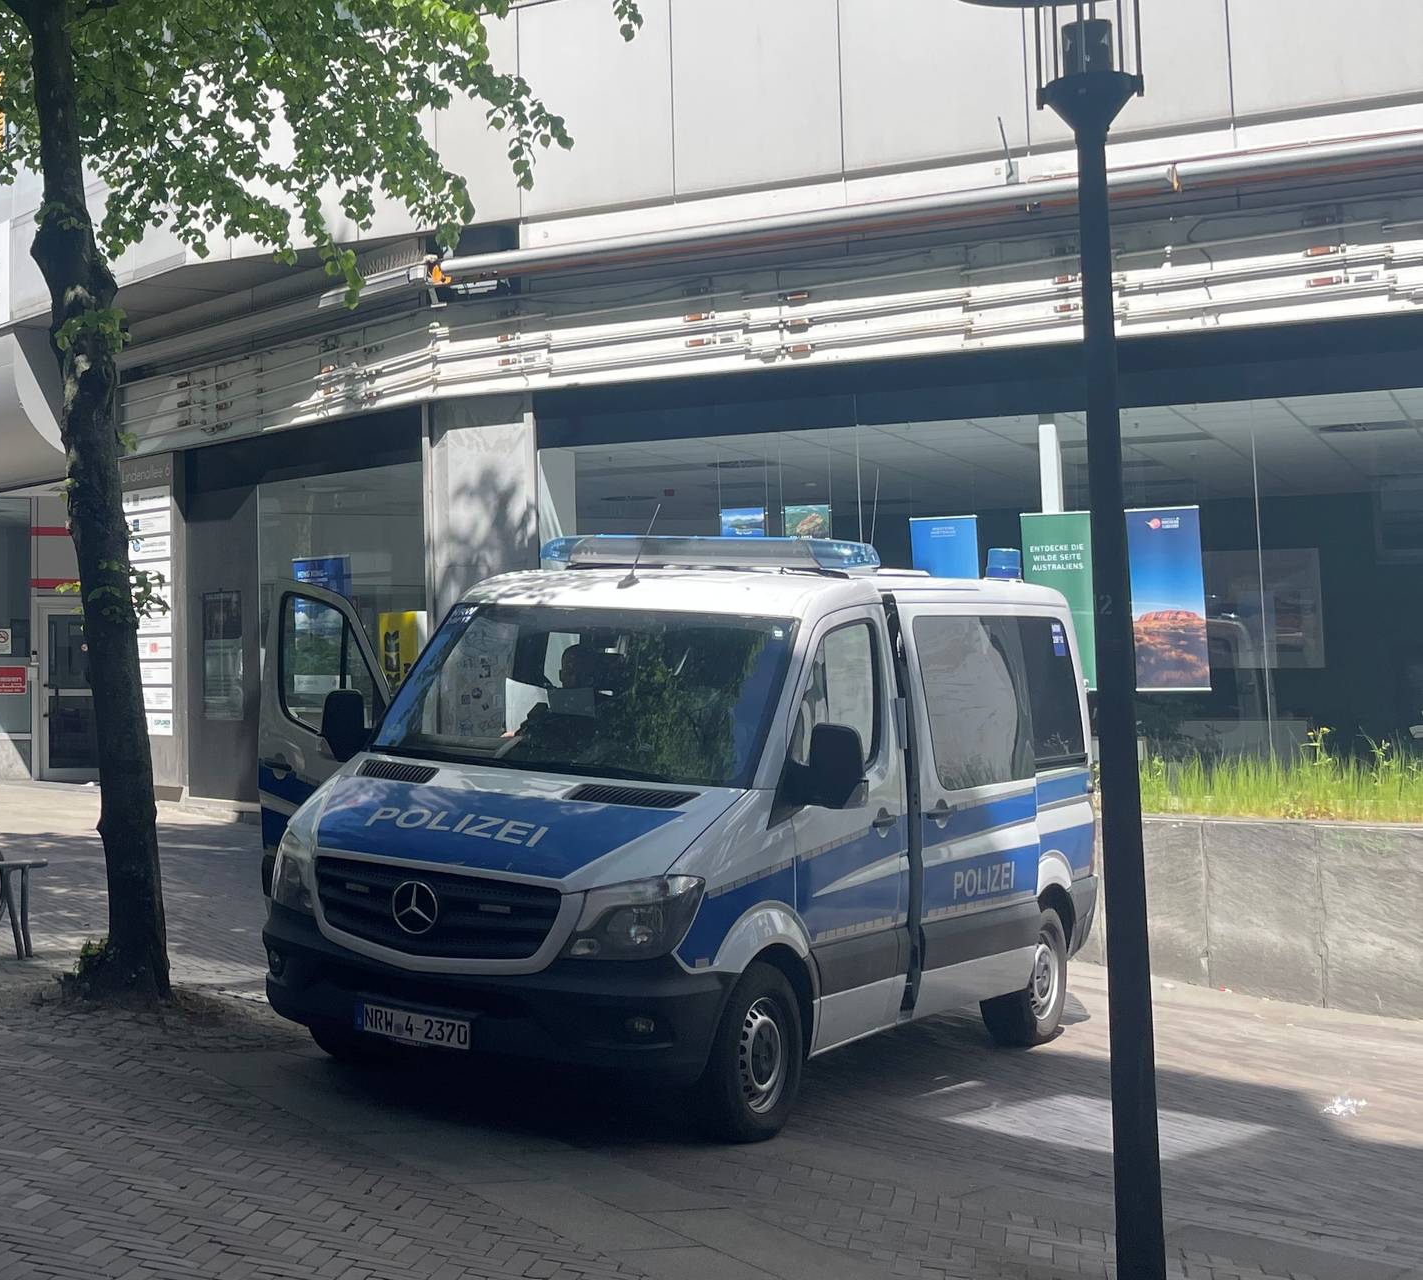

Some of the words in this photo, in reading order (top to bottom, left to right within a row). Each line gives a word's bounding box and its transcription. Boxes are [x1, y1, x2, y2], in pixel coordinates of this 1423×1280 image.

[122, 464, 163, 484] Lindenallee
[164, 464, 171, 477] 6
[1029, 544, 1069, 553] ENTDECKE
[1071, 543, 1085, 551] DIE
[1032, 554, 1058, 562] WILDE
[1032, 562, 1084, 572] AUSTRALIENS
[364, 807, 549, 848] POLIZEI
[953, 860, 1016, 900] POLIZEI
[364, 1007, 394, 1033] NRW
[405, 1015, 469, 1045] 4-2370
